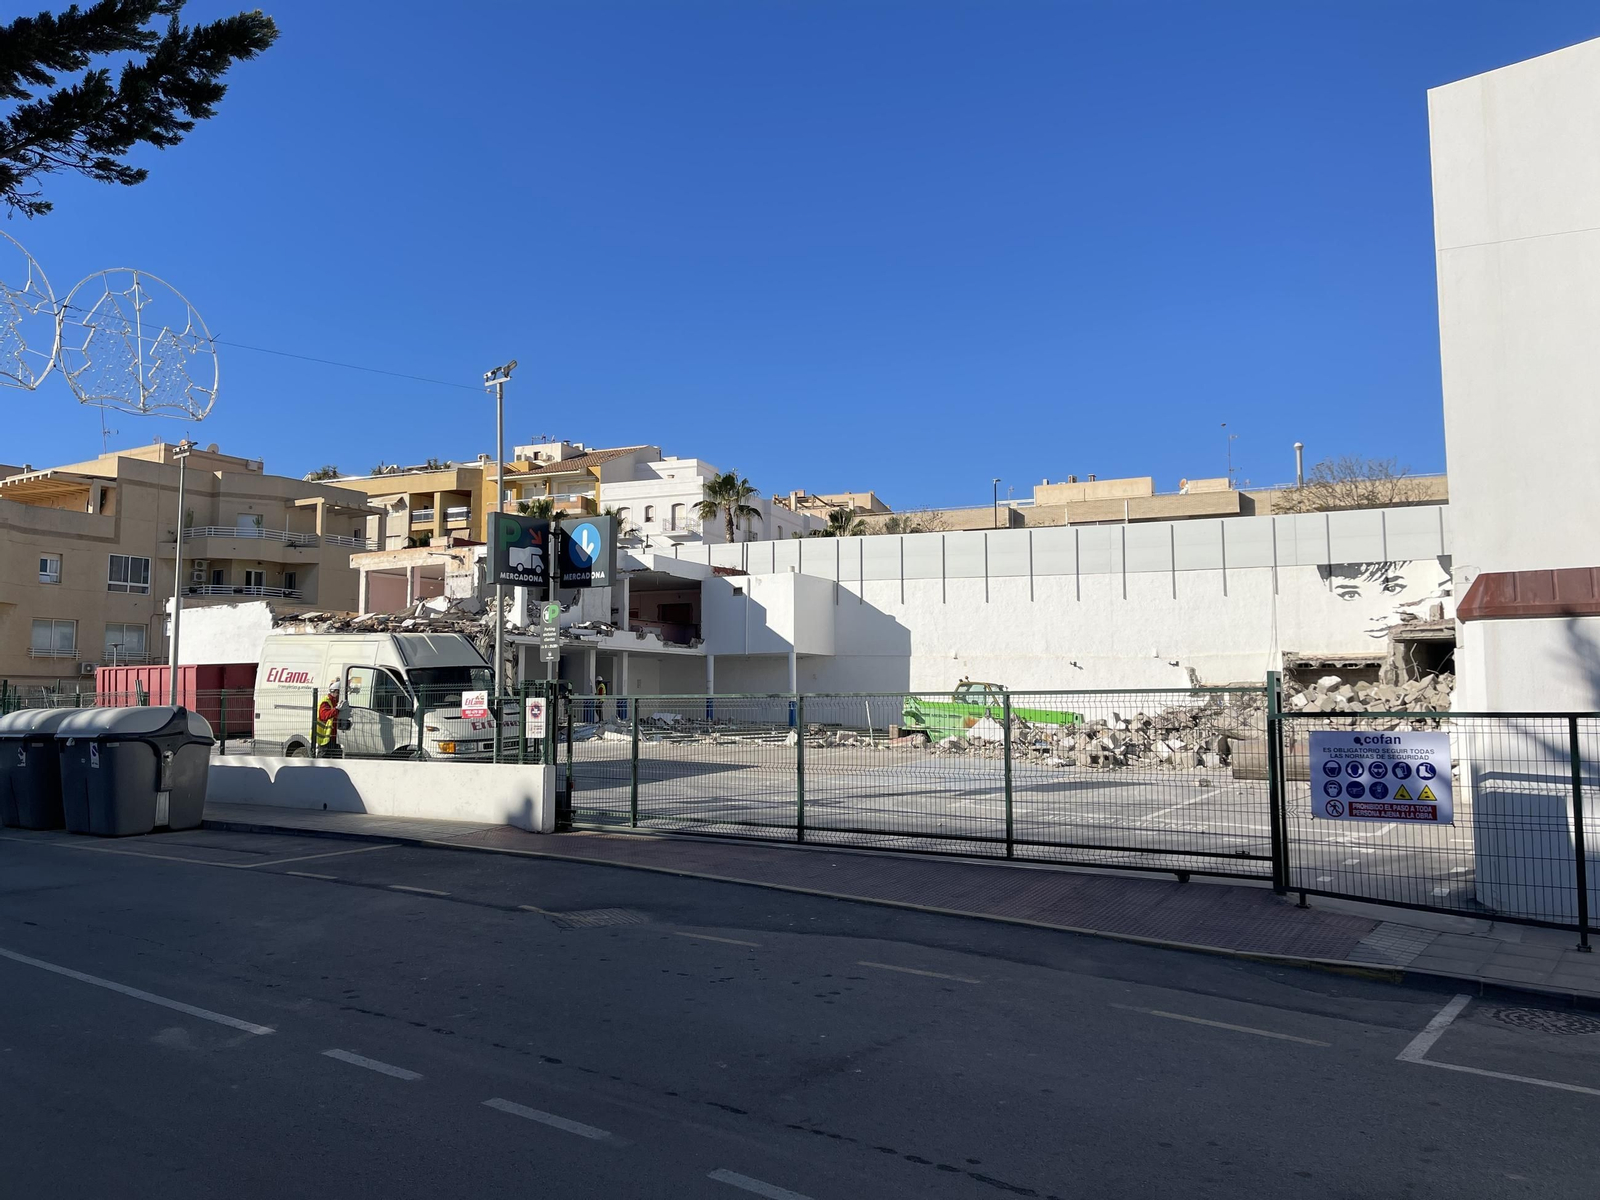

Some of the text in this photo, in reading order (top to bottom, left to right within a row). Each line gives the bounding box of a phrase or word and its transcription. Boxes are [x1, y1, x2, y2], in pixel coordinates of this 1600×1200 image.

[500, 518, 521, 551] P
[500, 572, 543, 583] MERCADONA
[563, 571, 605, 581] MERCADONA
[1364, 734, 1402, 745] cofan
[1415, 805, 1432, 813] TODA
